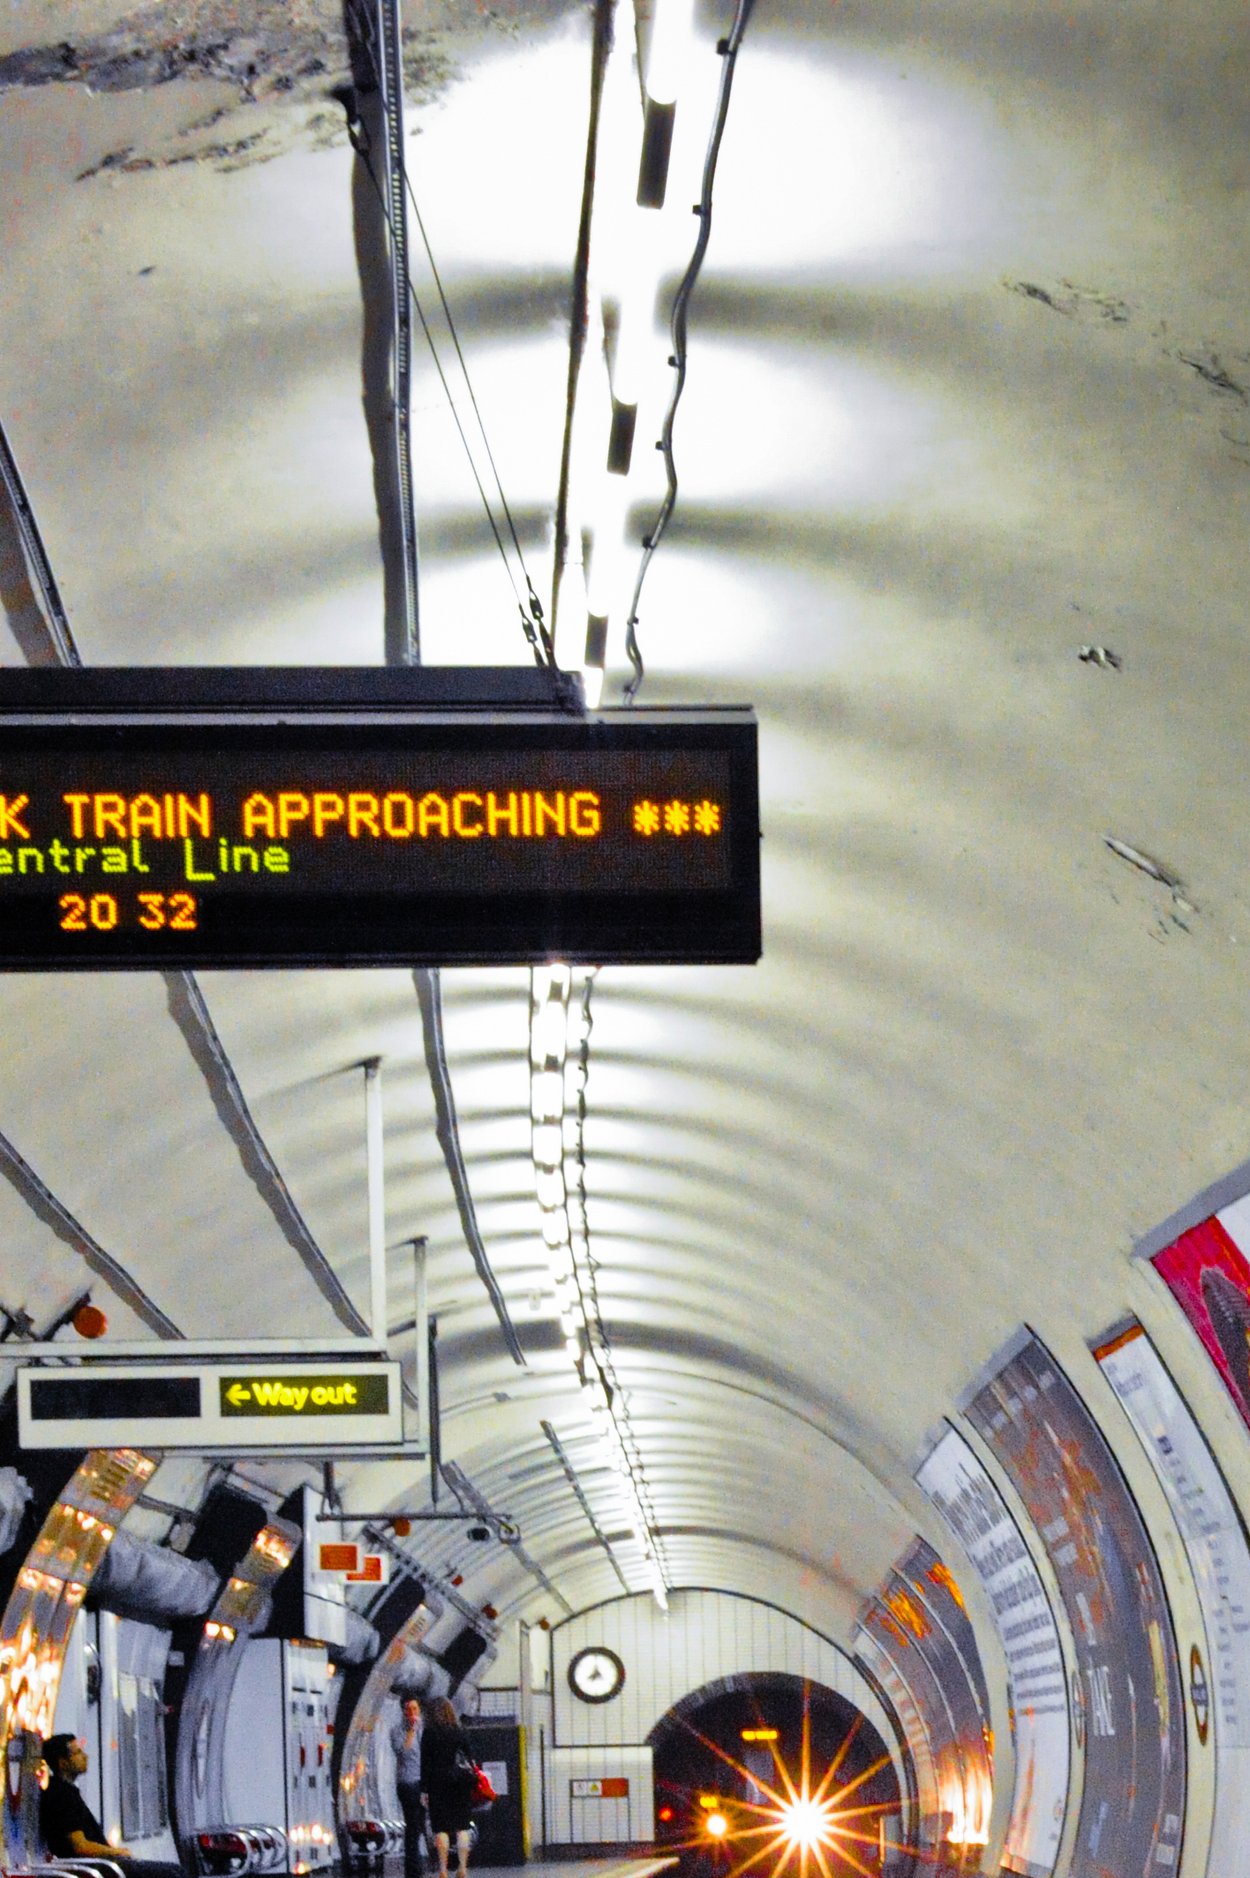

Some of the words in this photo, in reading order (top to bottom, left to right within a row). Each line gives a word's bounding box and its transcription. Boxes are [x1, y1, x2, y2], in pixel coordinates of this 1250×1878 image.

[63, 793, 211, 839] TRAIN
[243, 792, 600, 839] APPROACHING
[184, 837, 290, 882] Line
[59, 893, 118, 930] 20
[137, 893, 197, 930] 32
[251, 1382, 310, 1411] Way
[310, 1382, 358, 1405] out
